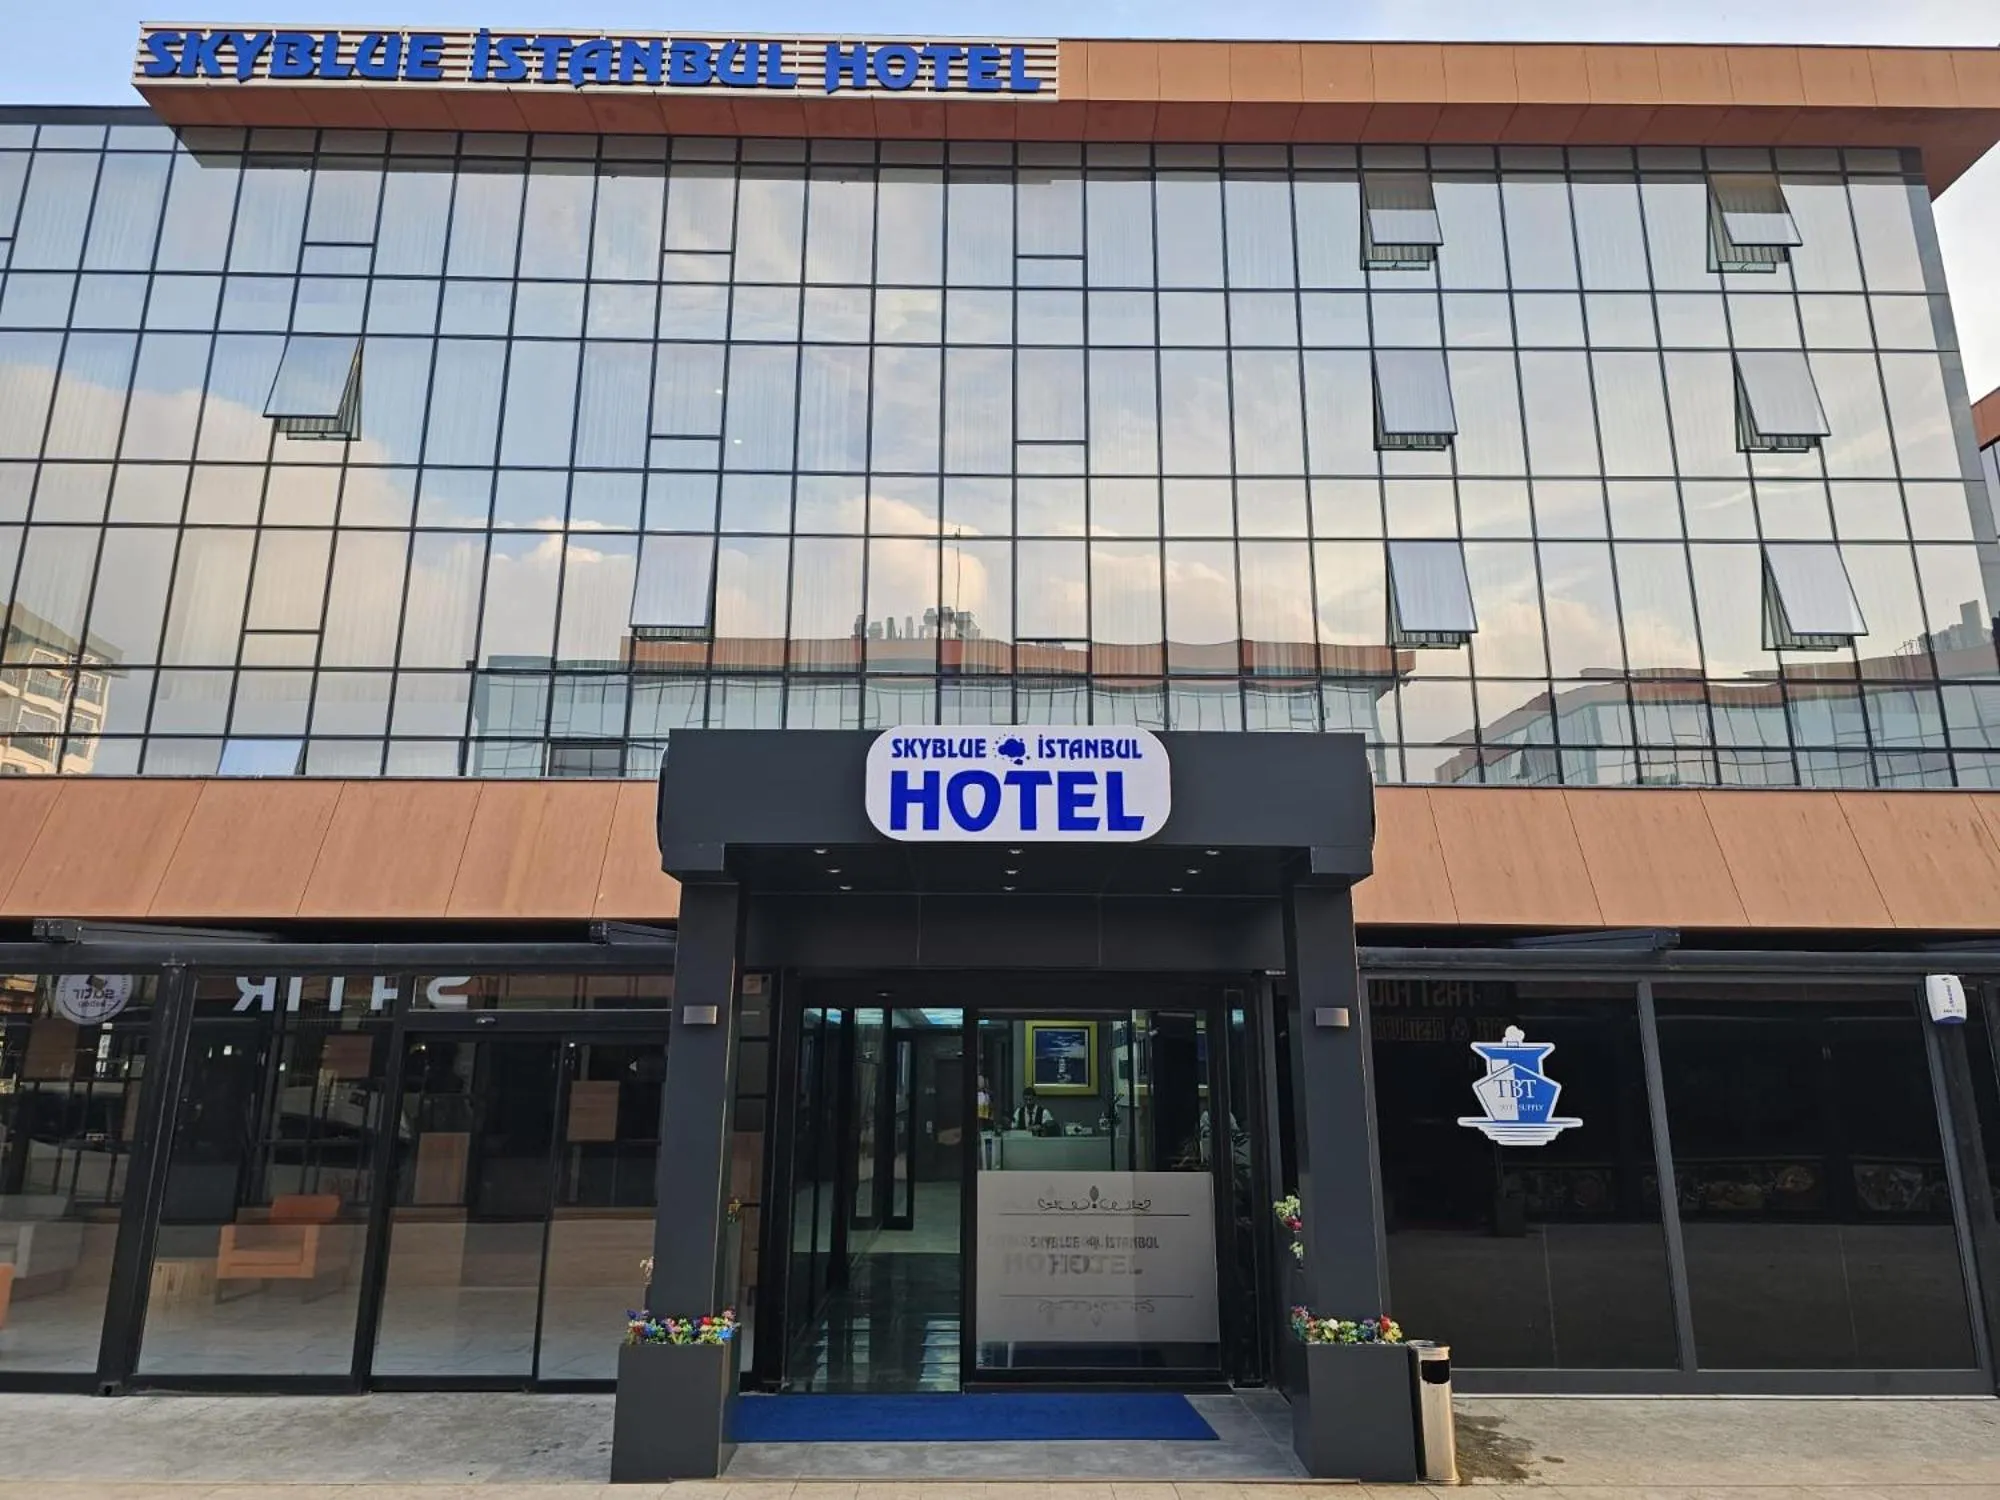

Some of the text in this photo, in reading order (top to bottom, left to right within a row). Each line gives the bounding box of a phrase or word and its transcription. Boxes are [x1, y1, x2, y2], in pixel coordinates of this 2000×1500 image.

[143, 28, 1041, 94] SKYBLUE İSTANBUL HOTEL
[891, 733, 1143, 761] SKYBLUE İSTANBUL
[889, 770, 1145, 832] HOTEL
[1493, 1079, 1537, 1099] TBT
